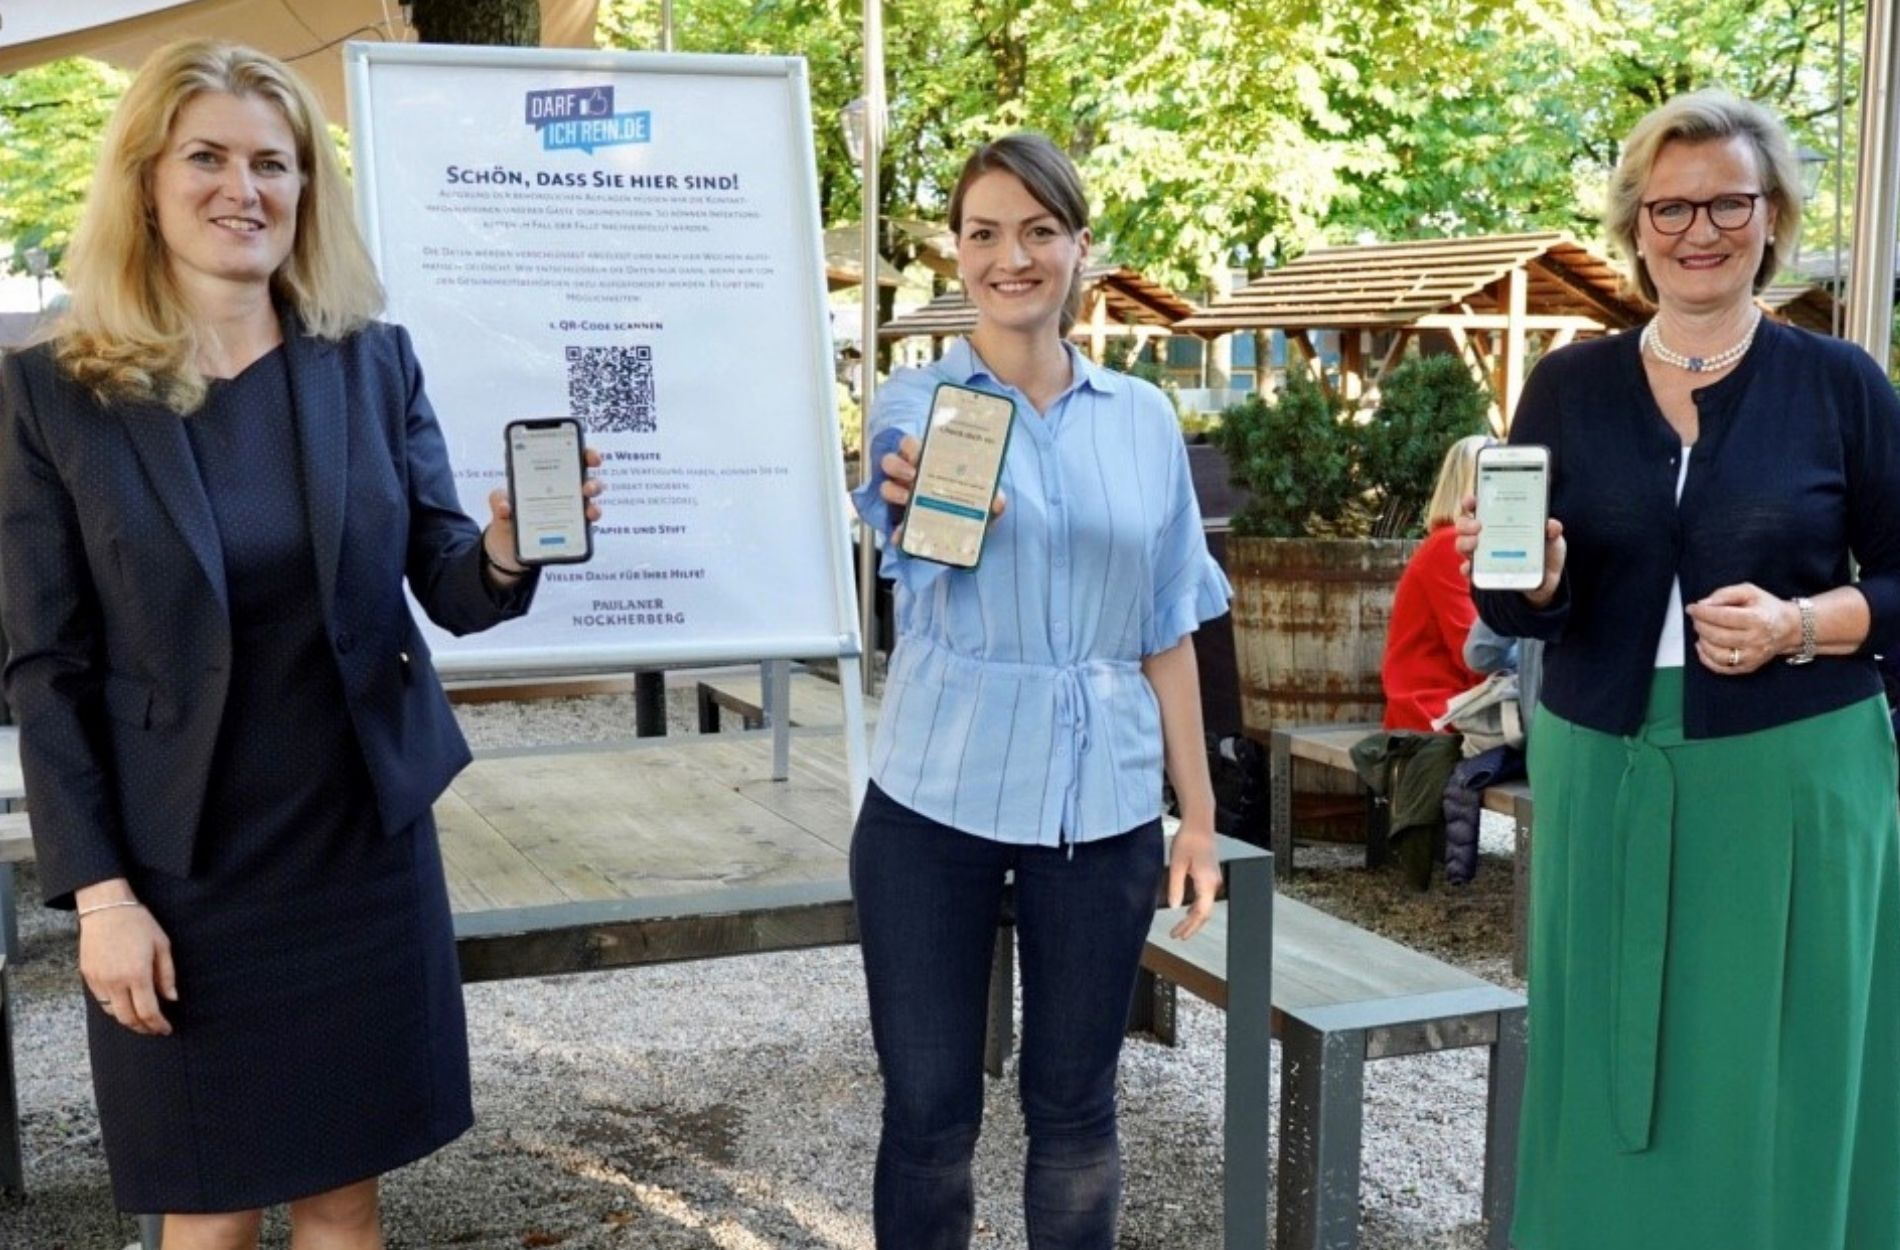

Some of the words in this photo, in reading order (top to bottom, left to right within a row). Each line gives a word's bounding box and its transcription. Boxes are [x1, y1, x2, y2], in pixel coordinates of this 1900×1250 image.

[531, 94, 577, 118] DARF
[549, 121, 577, 146] ICH
[581, 118, 647, 144] REIN.DE
[446, 165, 531, 189] SCHÖN,
[537, 172, 588, 188] DASS
[591, 171, 625, 189] SIE
[630, 174, 679, 190] HIER
[683, 174, 740, 191] SIND!
[559, 320, 611, 332] QR-CODE
[615, 451, 662, 461] WEBSITE
[592, 525, 631, 535] PAPIER
[633, 526, 656, 535] UND
[658, 524, 687, 535] STIFT
[545, 571, 583, 582] VIELEN
[585, 571, 617, 582] DANK
[619, 569, 641, 580] FÜR
[643, 569, 668, 579] IHRE
[592, 598, 664, 611] PAULANER
[572, 612, 686, 627] NOCKHERBERG
